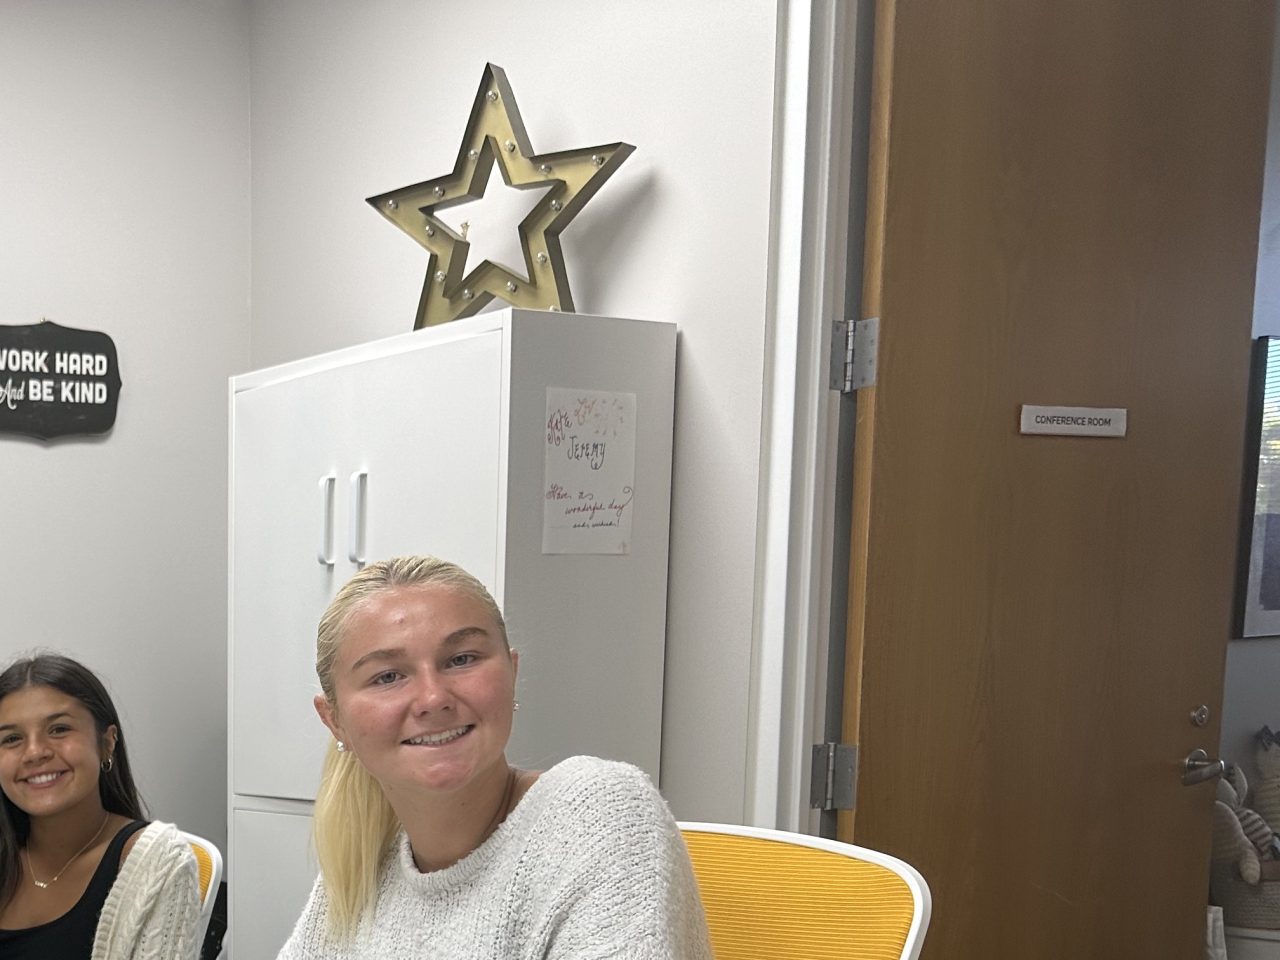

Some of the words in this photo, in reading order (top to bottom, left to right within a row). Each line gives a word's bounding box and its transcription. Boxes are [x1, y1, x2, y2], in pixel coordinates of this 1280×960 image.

[55, 352, 108, 376] HARD
[28, 379, 54, 402] BE
[61, 381, 108, 404] KIND
[1035, 415, 1086, 426] CONFERENCE
[1088, 418, 1111, 427] ROOM
